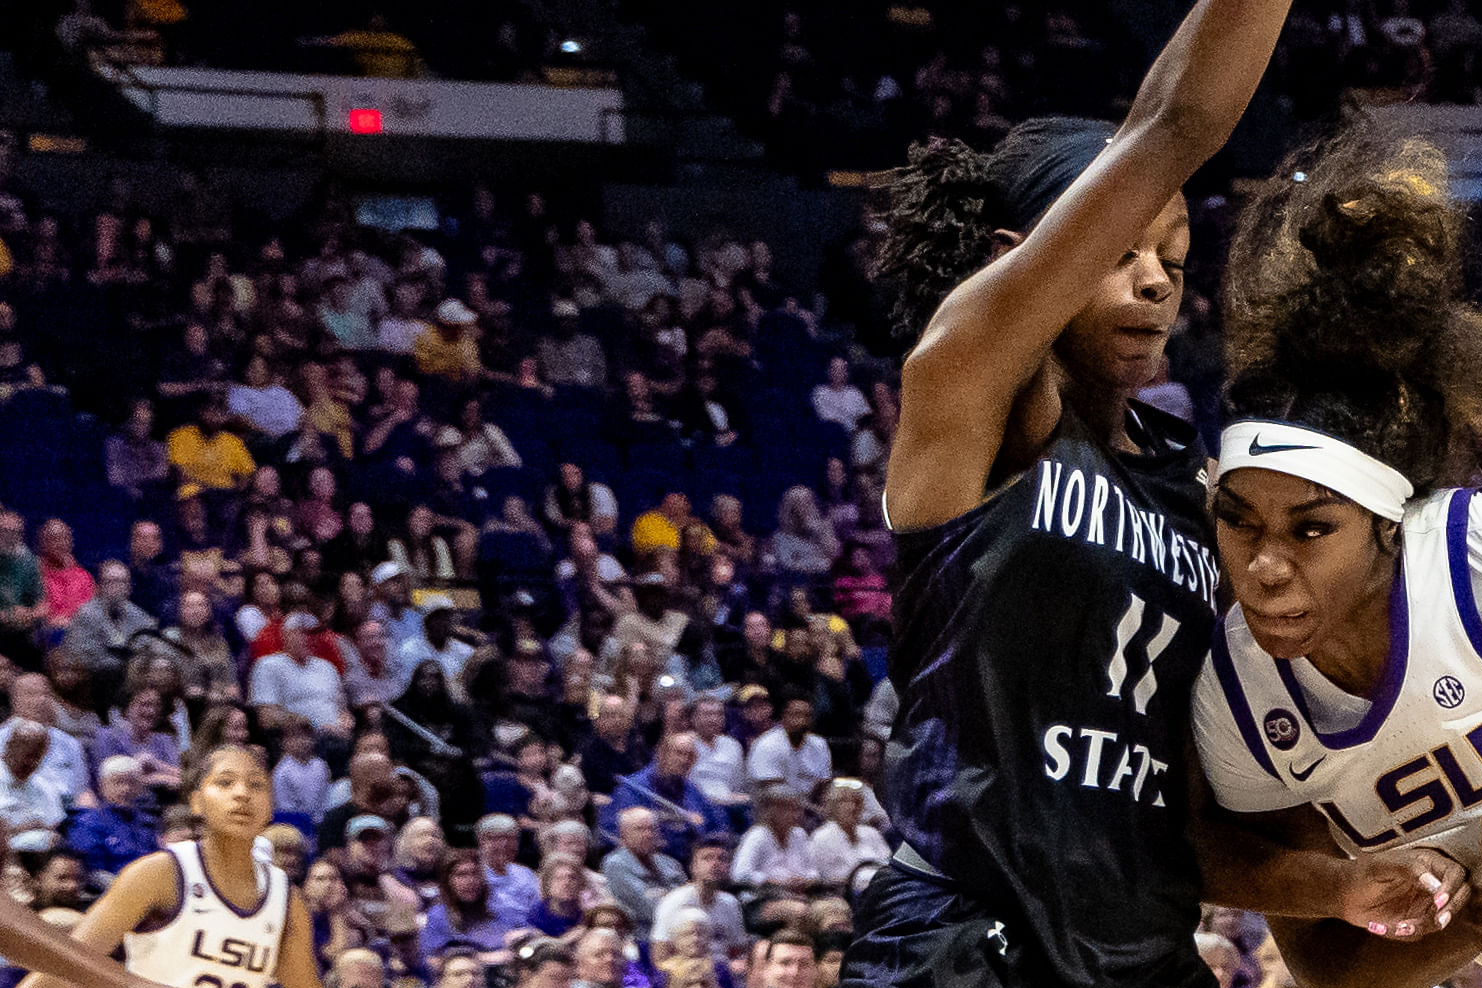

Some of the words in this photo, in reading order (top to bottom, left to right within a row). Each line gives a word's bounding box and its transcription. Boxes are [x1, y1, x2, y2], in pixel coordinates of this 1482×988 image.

[1106, 592, 1182, 715] 11
[1433, 676, 1465, 708] SEC
[191, 929, 271, 973] LSU
